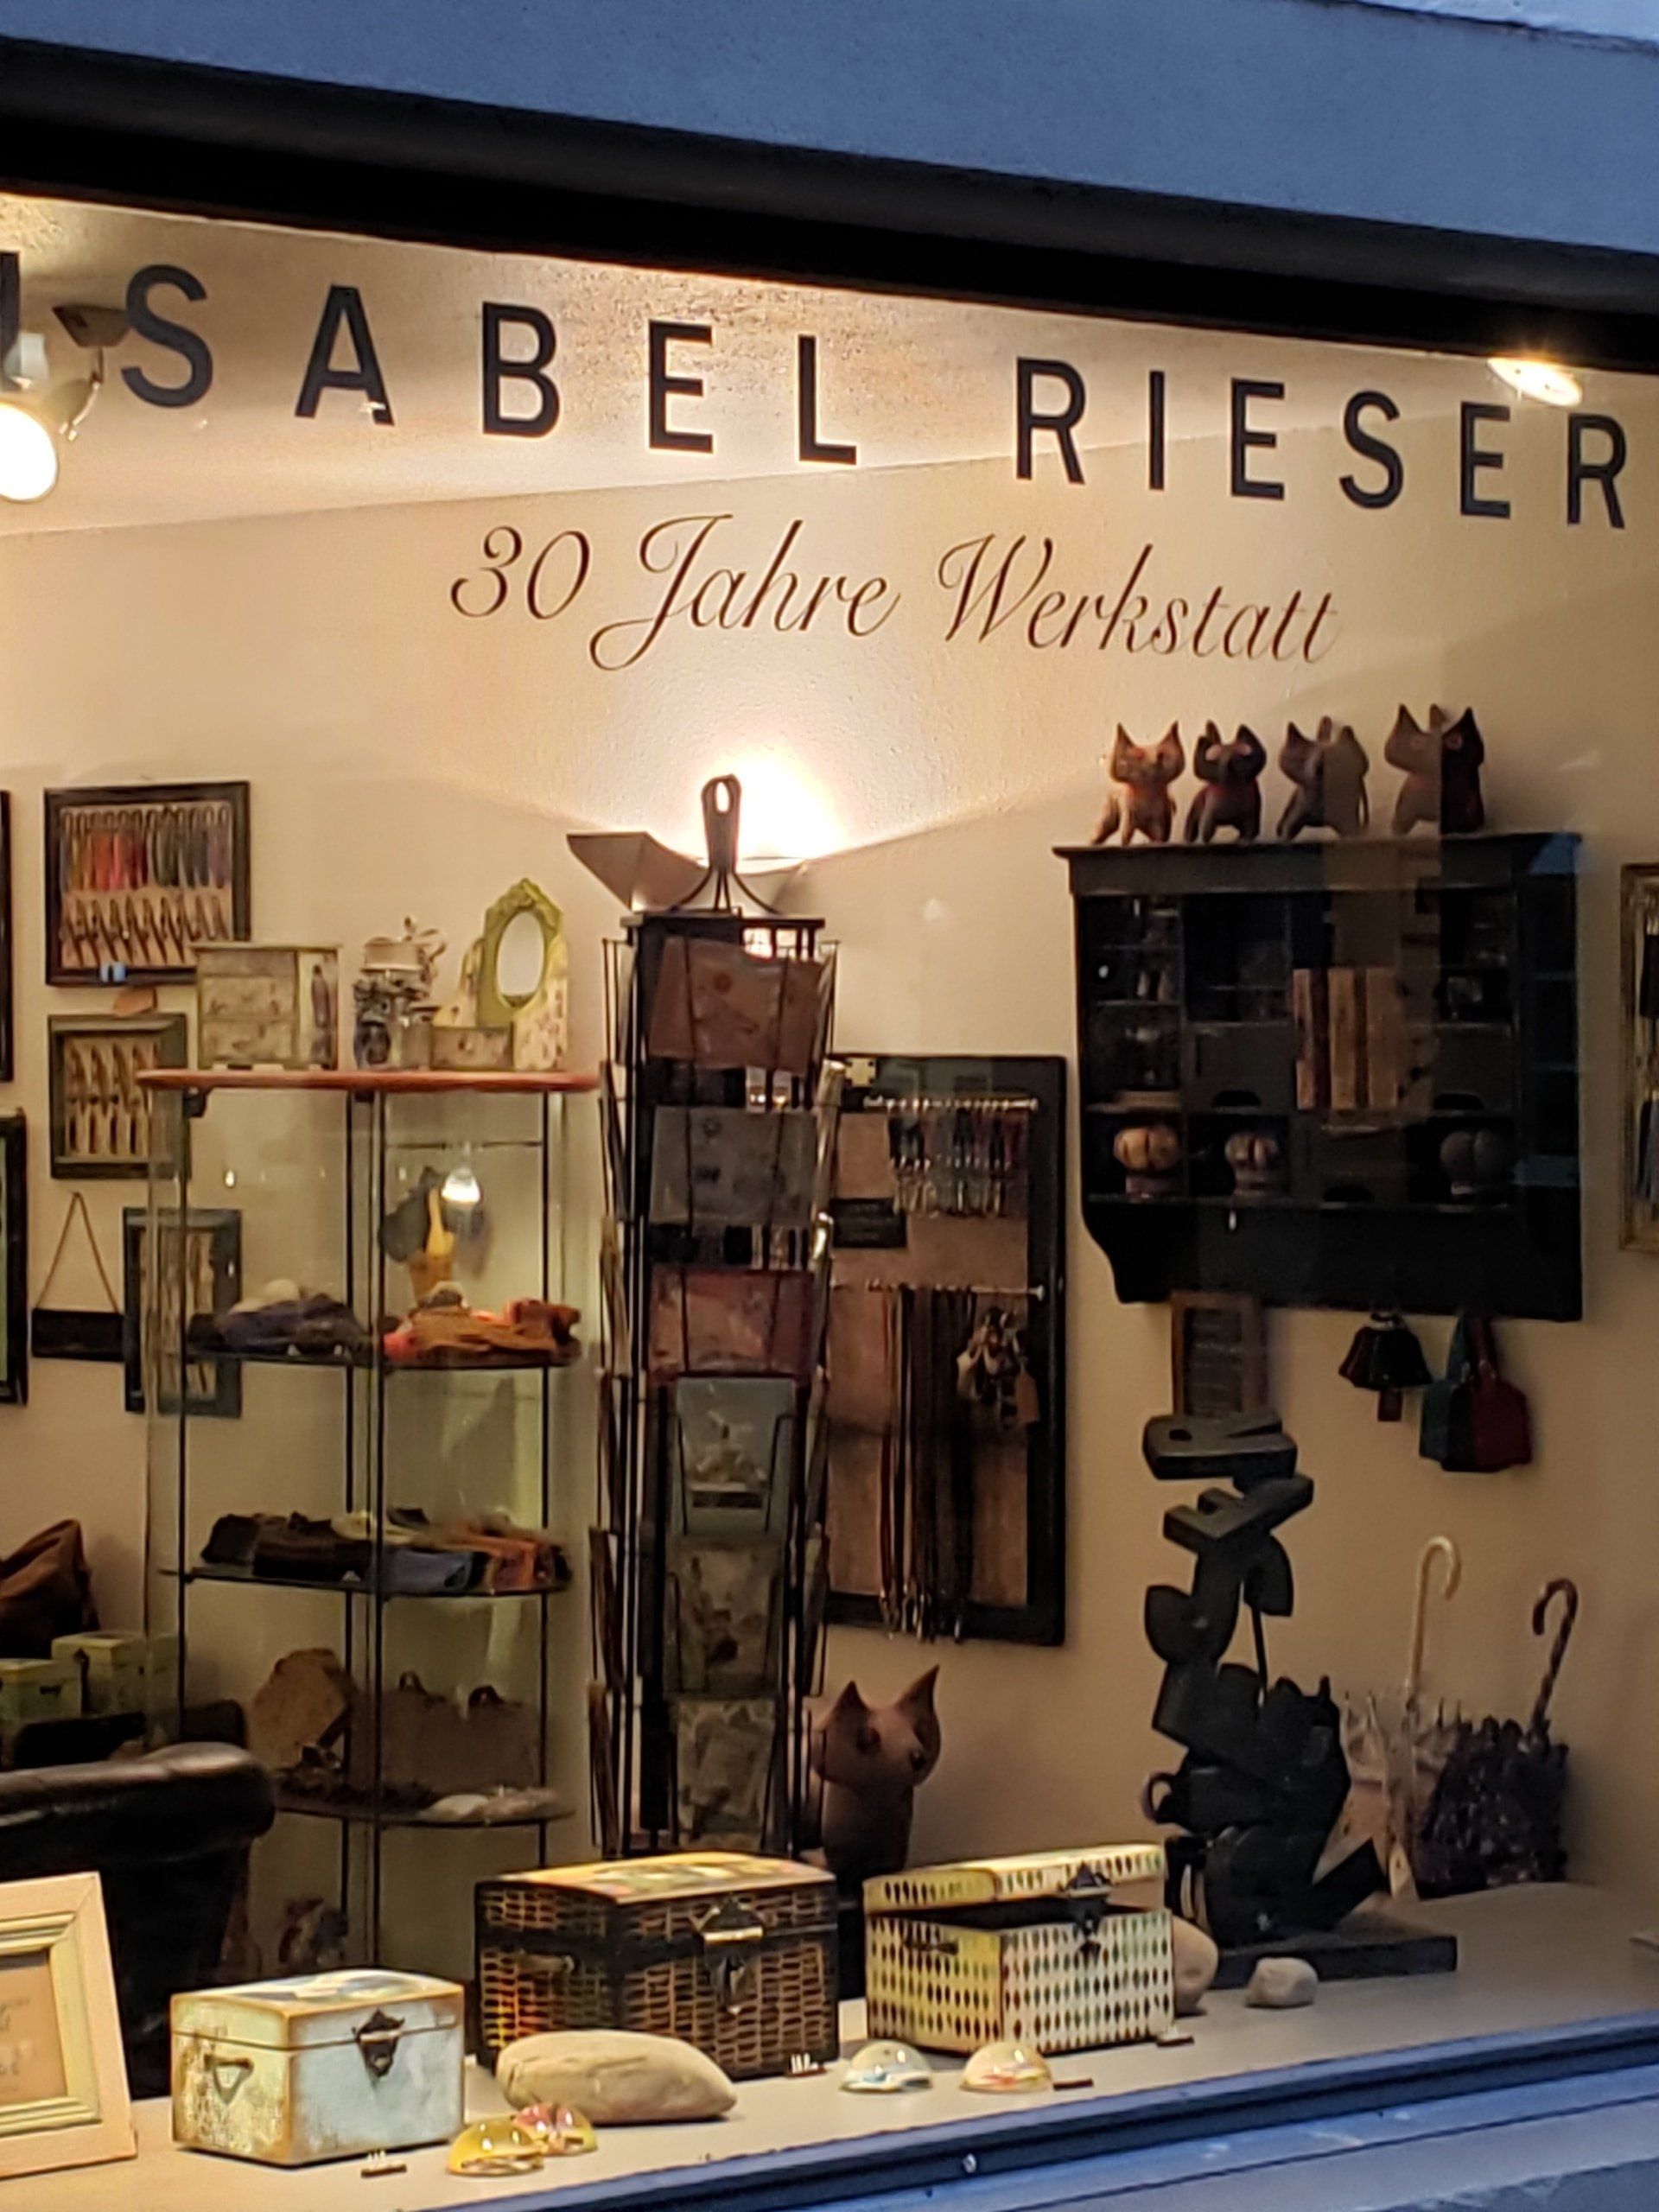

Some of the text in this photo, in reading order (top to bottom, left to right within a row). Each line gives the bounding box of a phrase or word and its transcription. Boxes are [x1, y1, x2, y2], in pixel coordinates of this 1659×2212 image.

[0, 251, 1628, 530] ISABEL RIESER
[449, 513, 1342, 671] 30 Jahre Werkstatt
